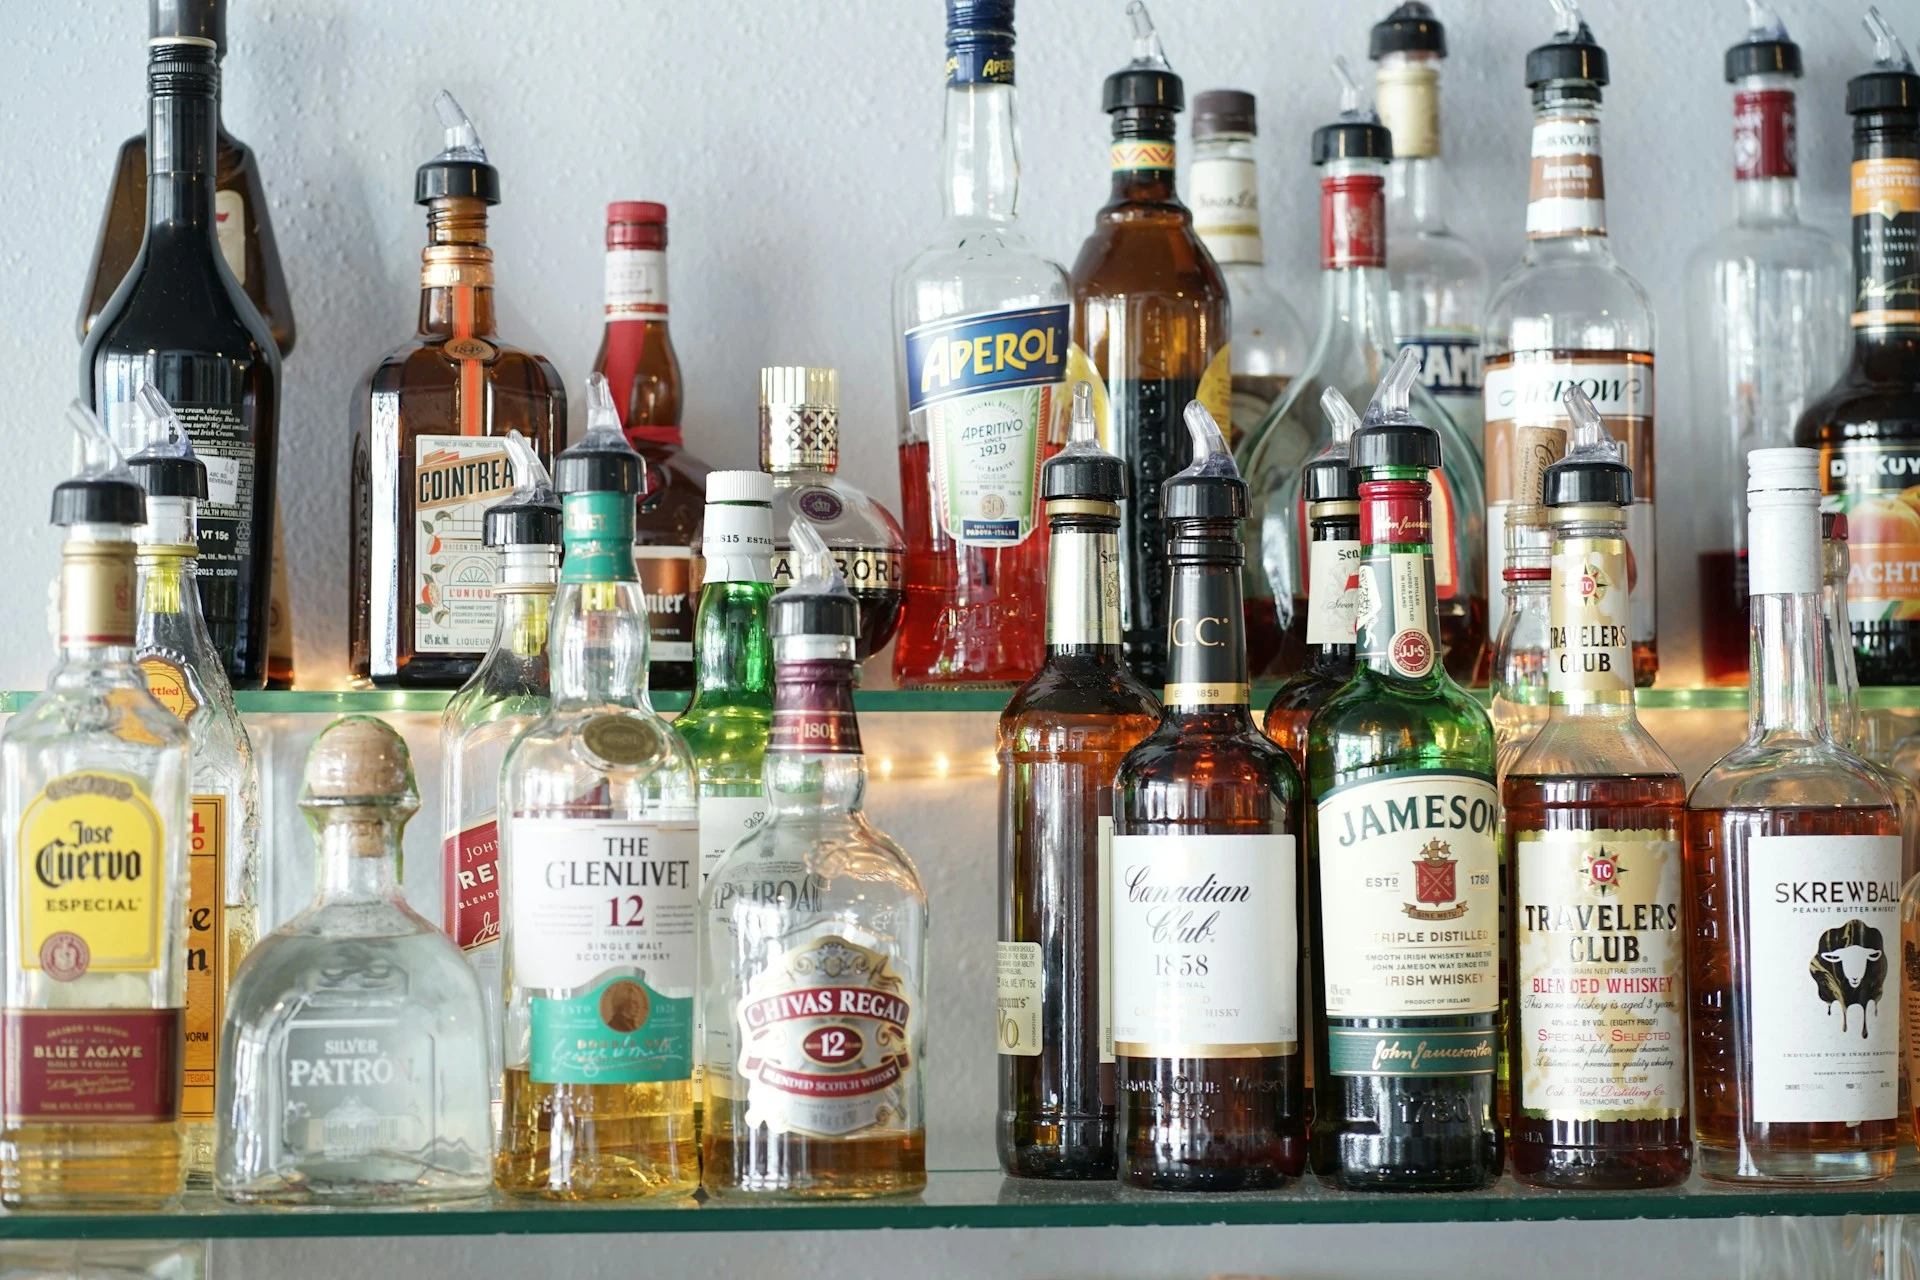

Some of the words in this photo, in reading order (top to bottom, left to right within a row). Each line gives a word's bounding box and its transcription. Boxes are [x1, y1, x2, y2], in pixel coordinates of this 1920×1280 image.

[921, 327, 1060, 393] APEROL
[962, 419, 1023, 441] APERITIVO
[980, 443, 1007, 457] 1919
[420, 458, 514, 503] COINTREA
[201, 530, 213, 539] VT
[774, 558, 901, 582] ABORD
[1580, 581, 1592, 592] TC
[645, 588, 686, 614] nier
[1550, 625, 1627, 650] TRAVELERS
[1560, 653, 1611, 673] CLUB
[151, 687, 179, 696] ttled
[804, 722, 836, 739] 1801
[1339, 795, 1498, 847] JAMESON
[69, 820, 113, 848] Jose
[603, 837, 649, 856] THE
[35, 838, 142, 889] Cuervo
[1595, 864, 1612, 879] TC
[545, 861, 689, 889] GLENLIVET
[1125, 865, 1252, 903] Canadian
[1470, 874, 1490, 885] 1780
[1775, 881, 1900, 904] SKREWBALL
[46, 898, 139, 912] ESPECIAL
[606, 894, 645, 928] 12
[1525, 903, 1677, 931] TRAVELERS
[1374, 931, 1424, 943] TRIPLE
[1430, 930, 1489, 942] DISTILLED
[587, 942, 631, 950] SINGLE
[637, 942, 663, 950] MALT
[1570, 936, 1640, 963] CLUB
[576, 953, 625, 962] SCOTCH
[631, 953, 671, 961] WHISKY
[1429, 952, 1464, 960] WHISKEY
[1396, 963, 1436, 971] JAMESON
[1594, 967, 1627, 975] NEUTRAL
[1159, 981, 1205, 989] ORGINAL
[1385, 975, 1425, 986] IRISH
[1429, 973, 1484, 985] WHISKEY
[1533, 978, 1600, 994] BLENDED
[1606, 976, 1673, 994] WHISKEY
[746, 990, 833, 1027] CHIVAS
[839, 989, 907, 1025] REGAL
[1621, 997, 1644, 1015] aged
[33, 1046, 79, 1059] BLUE
[84, 1046, 143, 1059] AGAVE
[325, 1039, 378, 1055] SILVER
[821, 1031, 846, 1057] 12
[763, 1068, 814, 1090] BLENDED
[815, 1081, 860, 1092] SCOTCH
[862, 1065, 898, 1088] WHISKY
